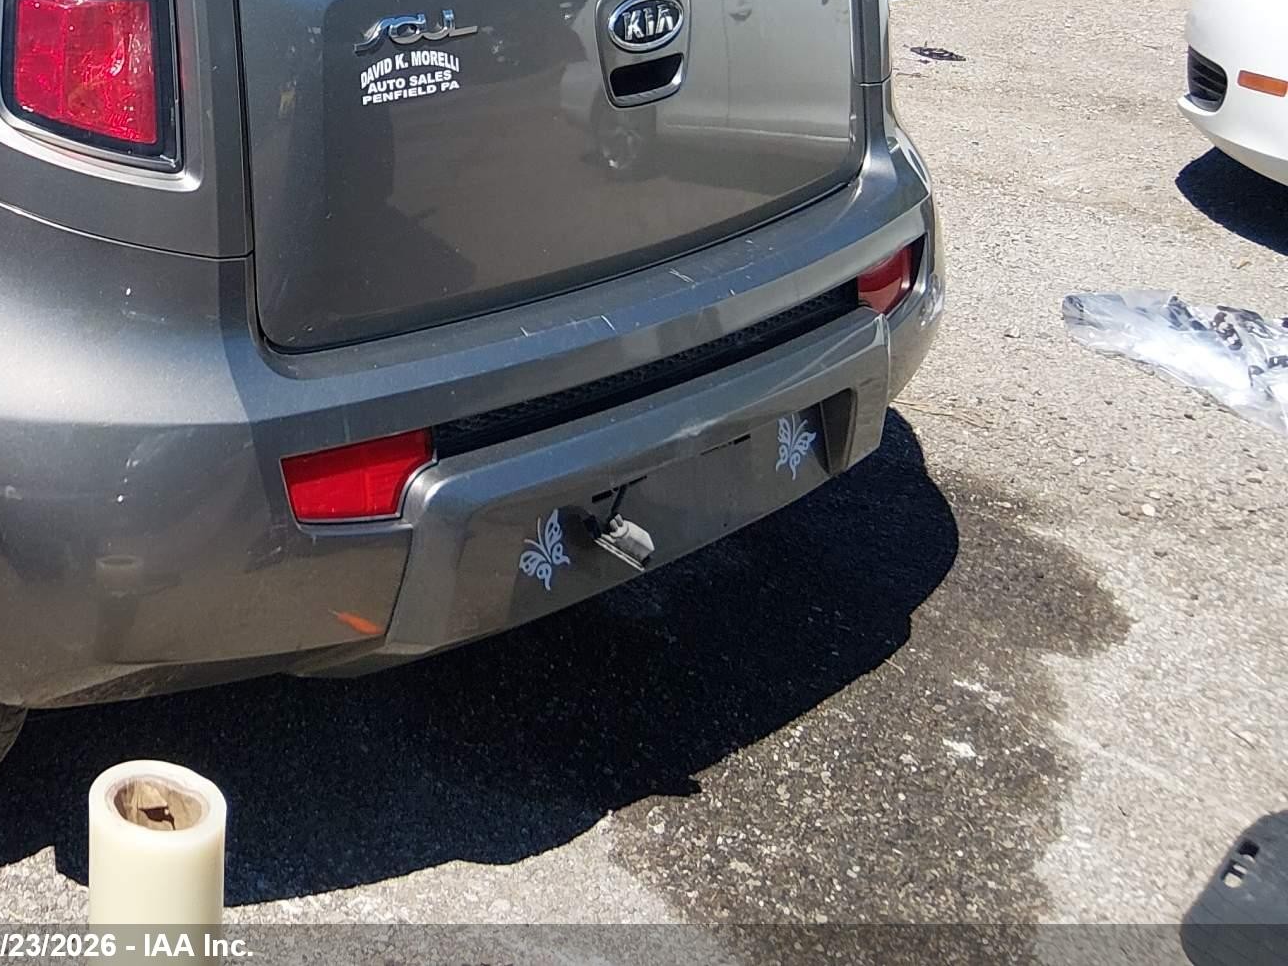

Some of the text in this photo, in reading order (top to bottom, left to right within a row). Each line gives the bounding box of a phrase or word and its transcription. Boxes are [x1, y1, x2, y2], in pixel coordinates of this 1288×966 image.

[354, 9, 478, 53] SOUL
[622, 4, 674, 41] KIA
[360, 50, 460, 89] DAVID K. MORELLI
[367, 69, 452, 95] AUTO SALES
[362, 80, 460, 106] PENFIELD PA
